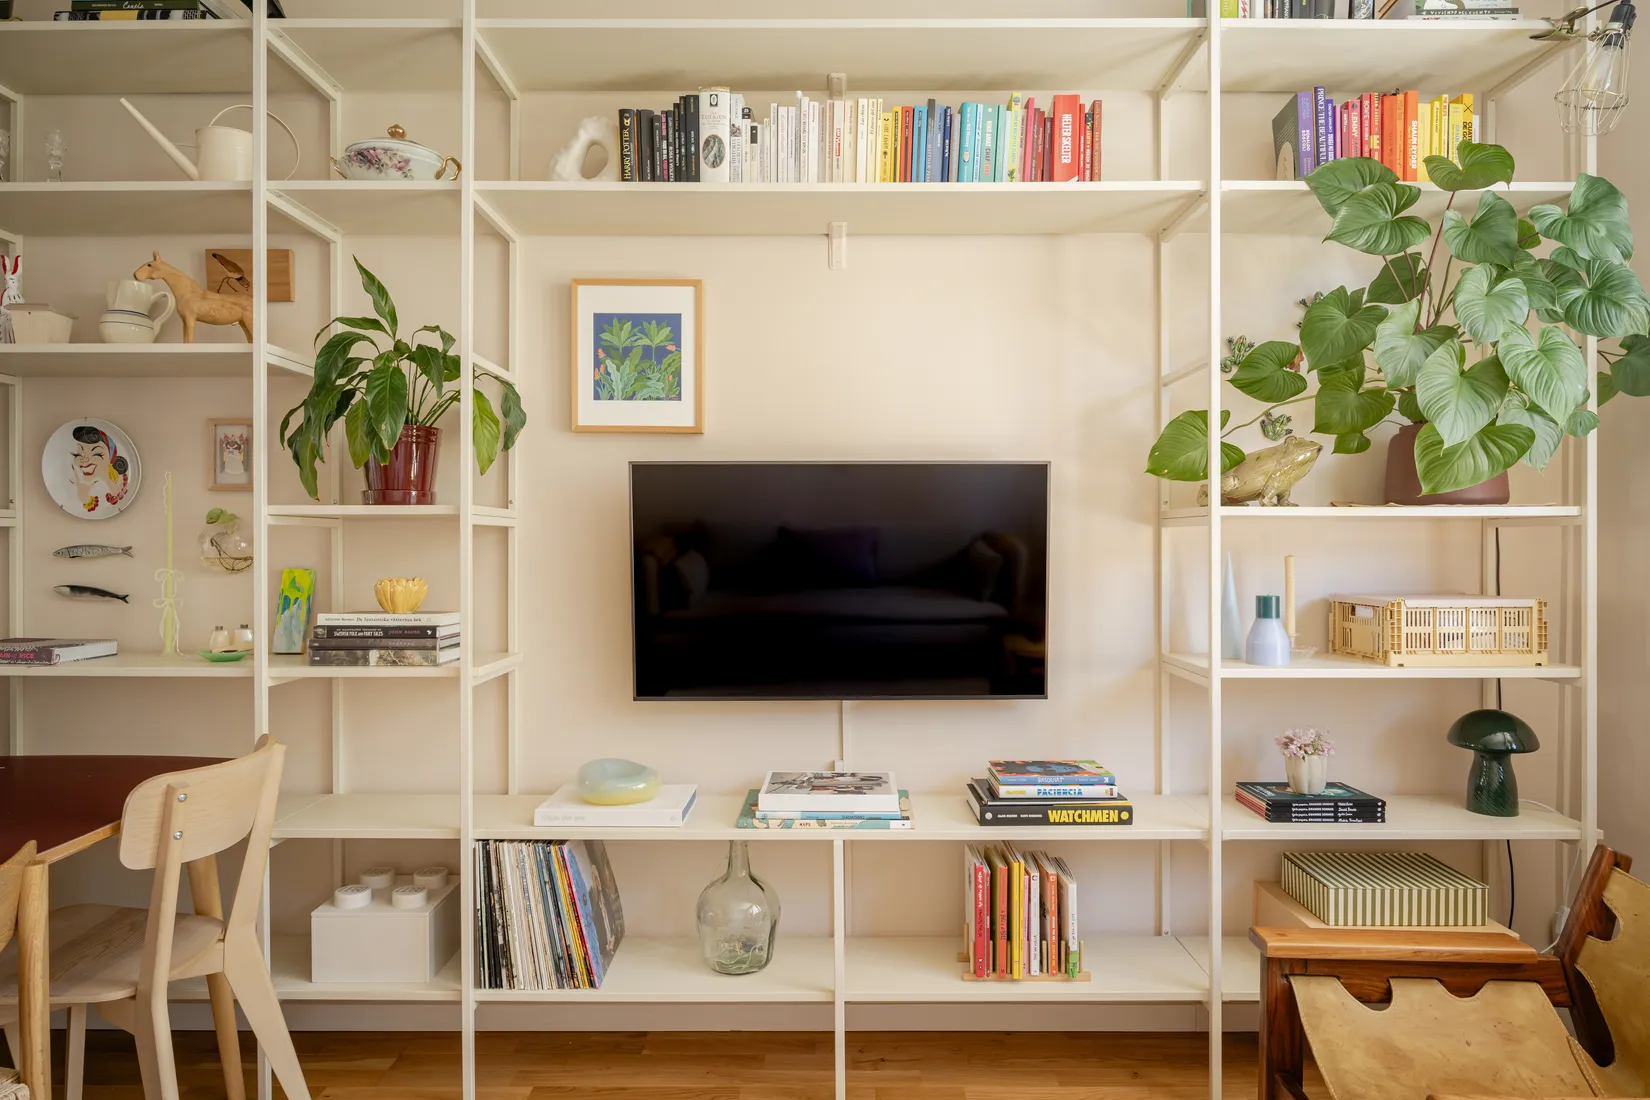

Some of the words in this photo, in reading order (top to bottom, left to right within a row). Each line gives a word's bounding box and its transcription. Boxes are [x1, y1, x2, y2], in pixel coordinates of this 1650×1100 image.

[1317, 88, 1325, 113] PRINCE
[1061, 114, 1073, 136] HELTER
[1318, 113, 1326, 126] THE
[1462, 121, 1468, 130] DE
[622, 127, 631, 154] POTTER
[1061, 137, 1072, 164] SKELTER
[1319, 126, 1327, 161] BEAUTIFUL
[623, 155, 632, 180] HARRY
[1037, 788, 1083, 796] PACIENCIA
[1047, 809, 1119, 823] WATCHMEN
